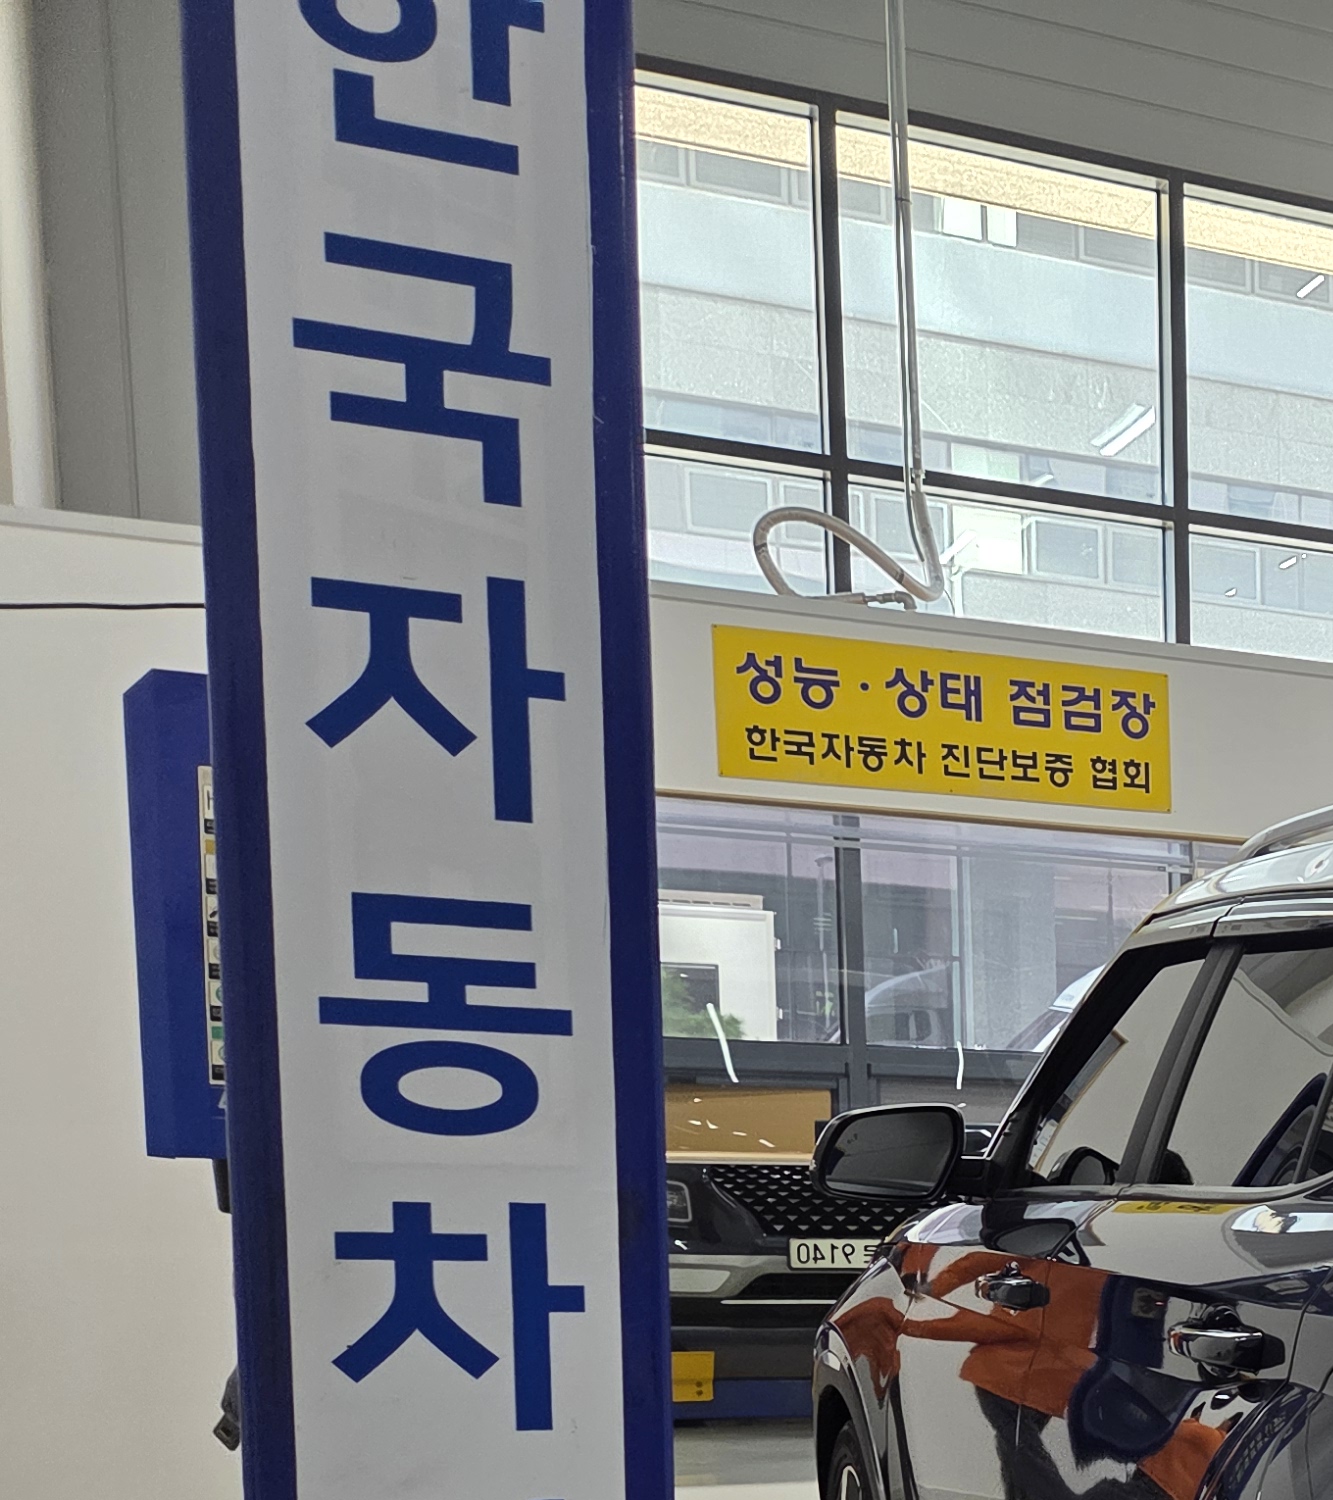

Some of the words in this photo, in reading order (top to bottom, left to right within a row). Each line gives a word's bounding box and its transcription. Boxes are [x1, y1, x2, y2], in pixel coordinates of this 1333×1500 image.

[1007, 677, 1157, 741] 점검장
[744, 724, 928, 774] 한국자동차
[940, 743, 1075, 789] 진단보증
[1089, 754, 1153, 795] 협회
